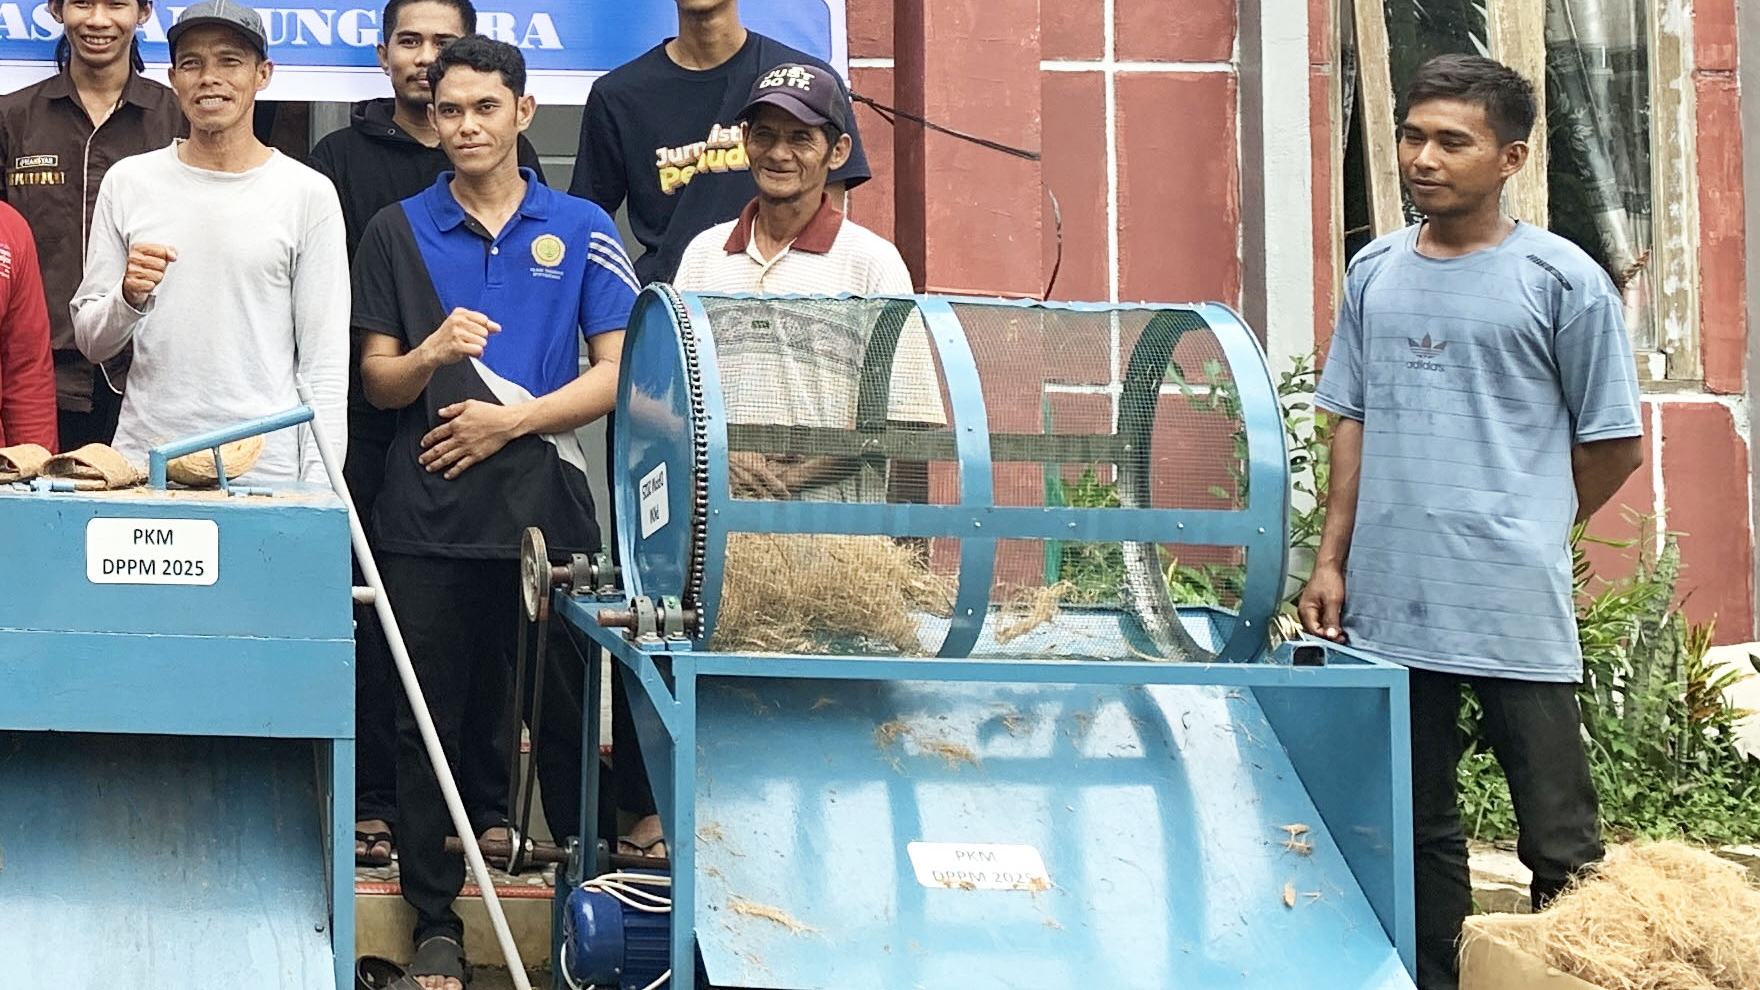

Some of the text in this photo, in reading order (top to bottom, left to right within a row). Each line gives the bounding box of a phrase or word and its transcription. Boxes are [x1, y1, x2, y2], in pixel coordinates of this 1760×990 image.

[764, 67, 816, 82] JUST
[759, 77, 811, 91] DO IT.
[1406, 360, 1445, 372] adidas
[133, 528, 173, 546] PKM
[103, 558, 204, 577] DPPM 2025
[955, 850, 997, 862] PKM
